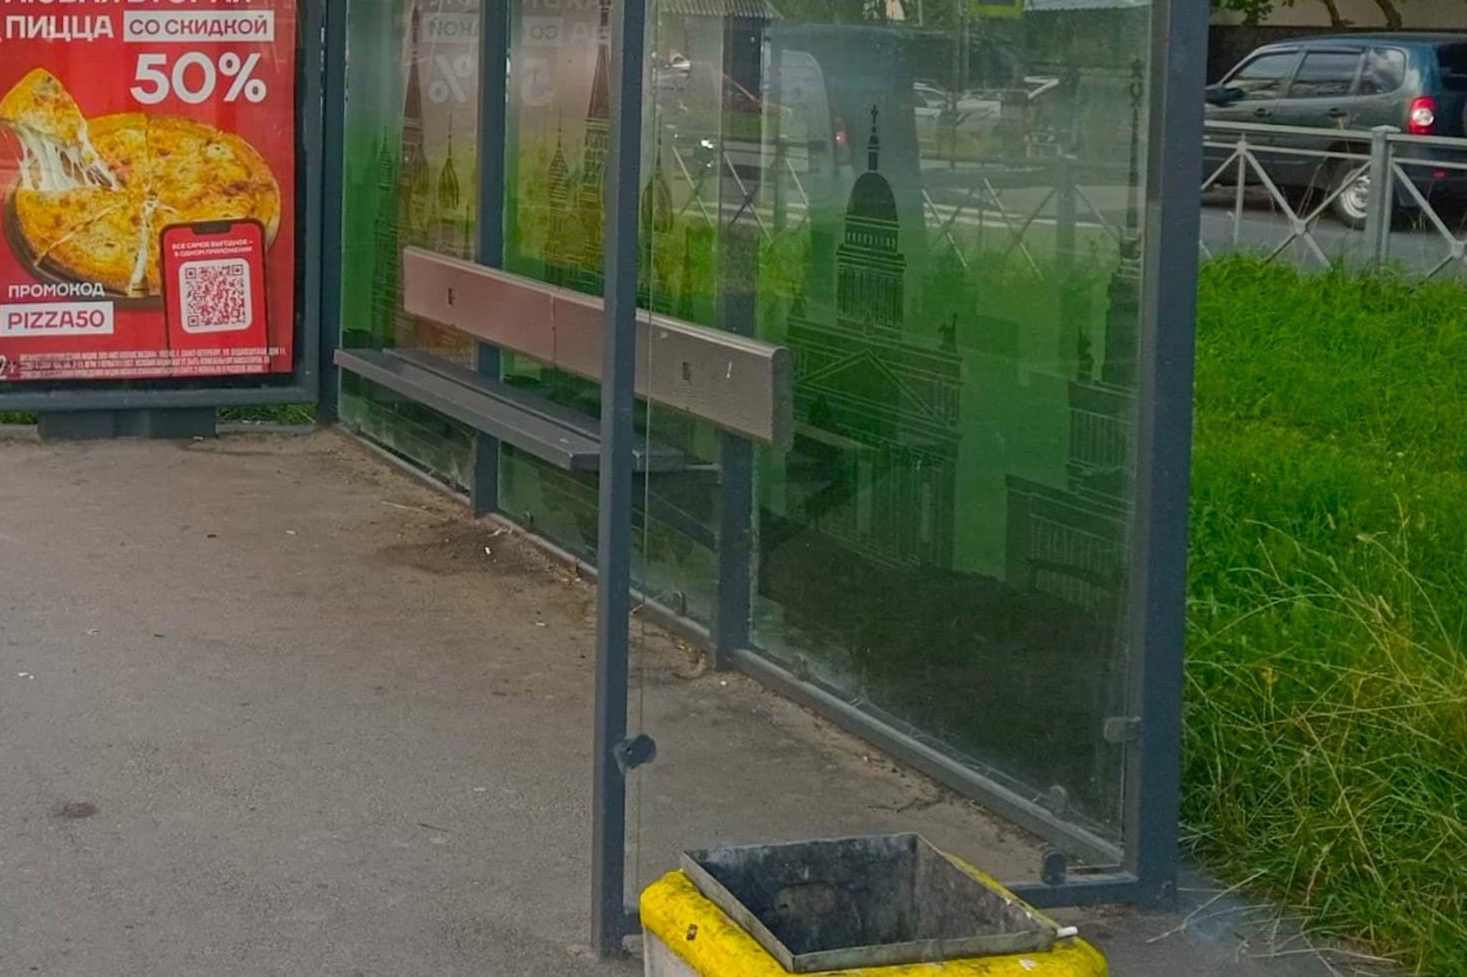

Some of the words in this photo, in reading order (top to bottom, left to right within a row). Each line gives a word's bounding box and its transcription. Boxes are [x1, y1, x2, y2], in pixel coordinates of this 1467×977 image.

[5, 15, 115, 42] ПИЦЦА
[129, 18, 160, 36] СО
[164, 13, 268, 36] СКИДКОЙ
[130, 51, 267, 104] 50%
[8, 282, 106, 298] ПРОМОКОД
[7, 309, 106, 330] PIZZA50
